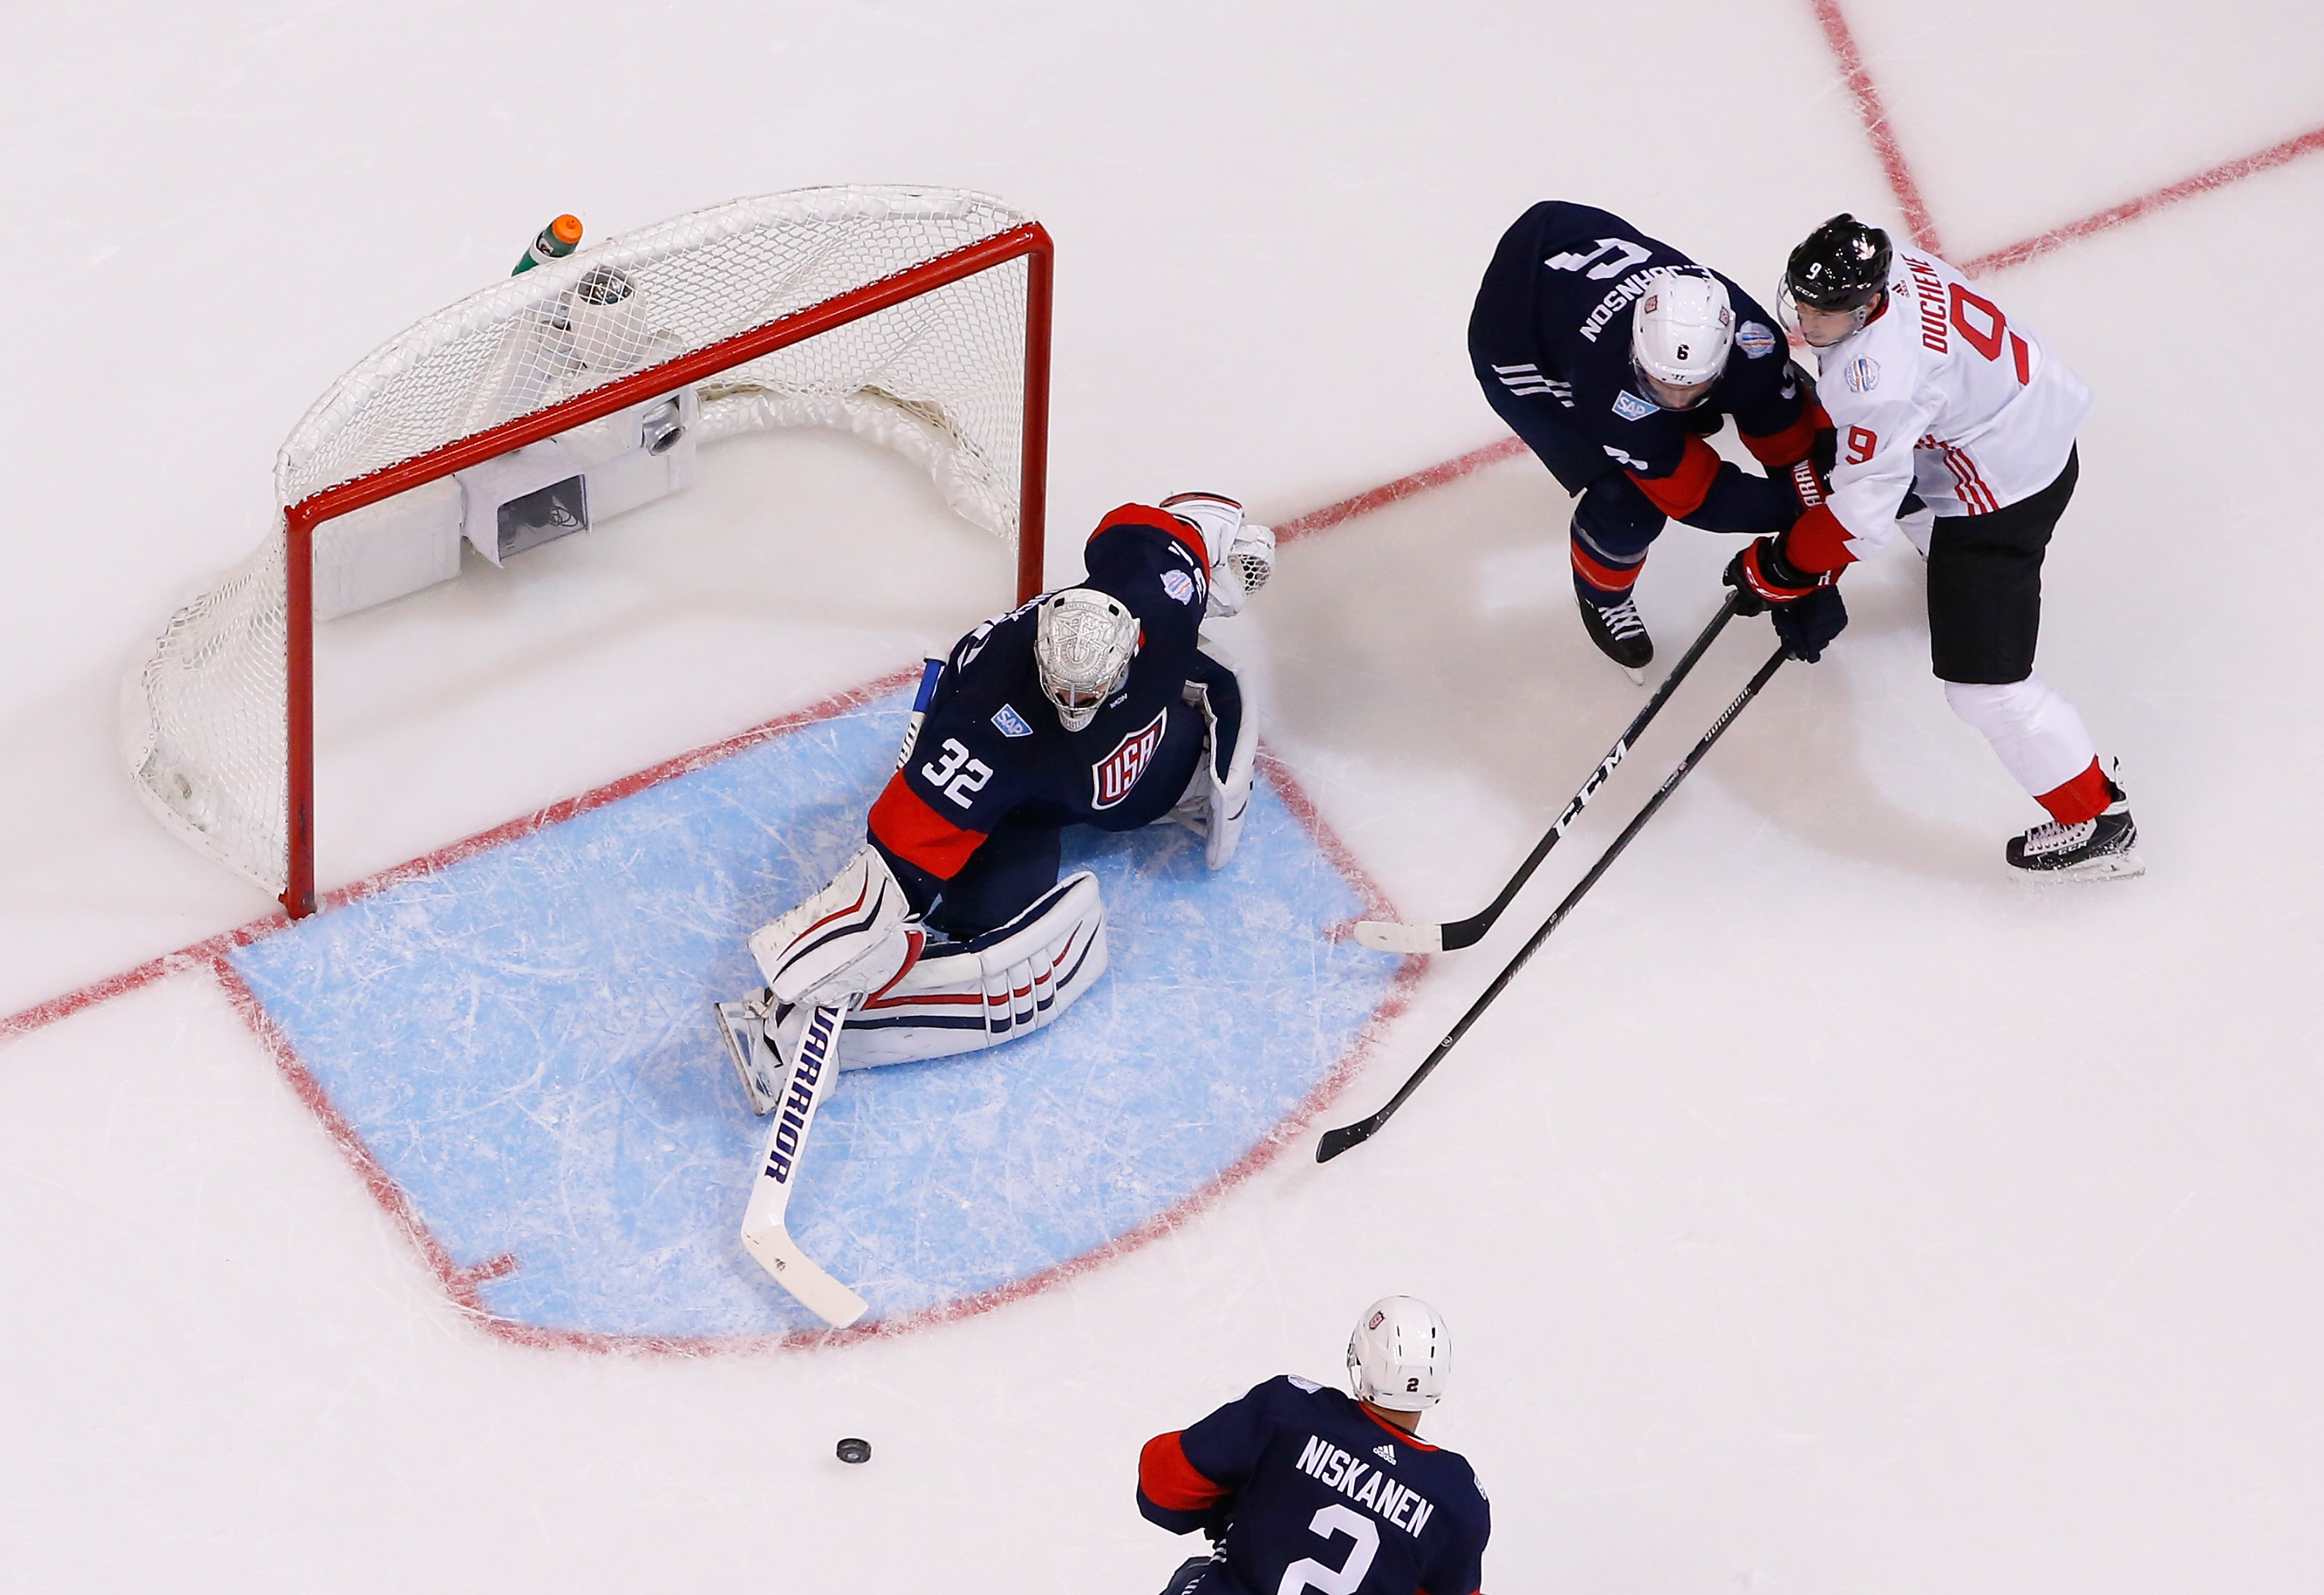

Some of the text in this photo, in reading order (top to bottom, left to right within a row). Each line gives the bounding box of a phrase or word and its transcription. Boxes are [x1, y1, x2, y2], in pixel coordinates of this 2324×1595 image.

[1805, 262, 1822, 280] 9
[1795, 285, 1818, 299] CCM
[1900, 253, 1948, 354] DUCHENE
[1677, 344, 1690, 360] 6
[1948, 282, 2030, 386] 9
[1618, 396, 1646, 417] SAP
[1845, 425, 1877, 465] 9
[997, 710, 1024, 734] SAP
[922, 737, 993, 810] 32
[1105, 730, 1155, 798] USA
[1552, 738, 1626, 837] CCM
[2058, 840, 2088, 856] CCM
[1406, 1377, 1419, 1392] 2
[1295, 1435, 1434, 1538] NISKANEN
[1277, 1503, 1380, 1595] 2
